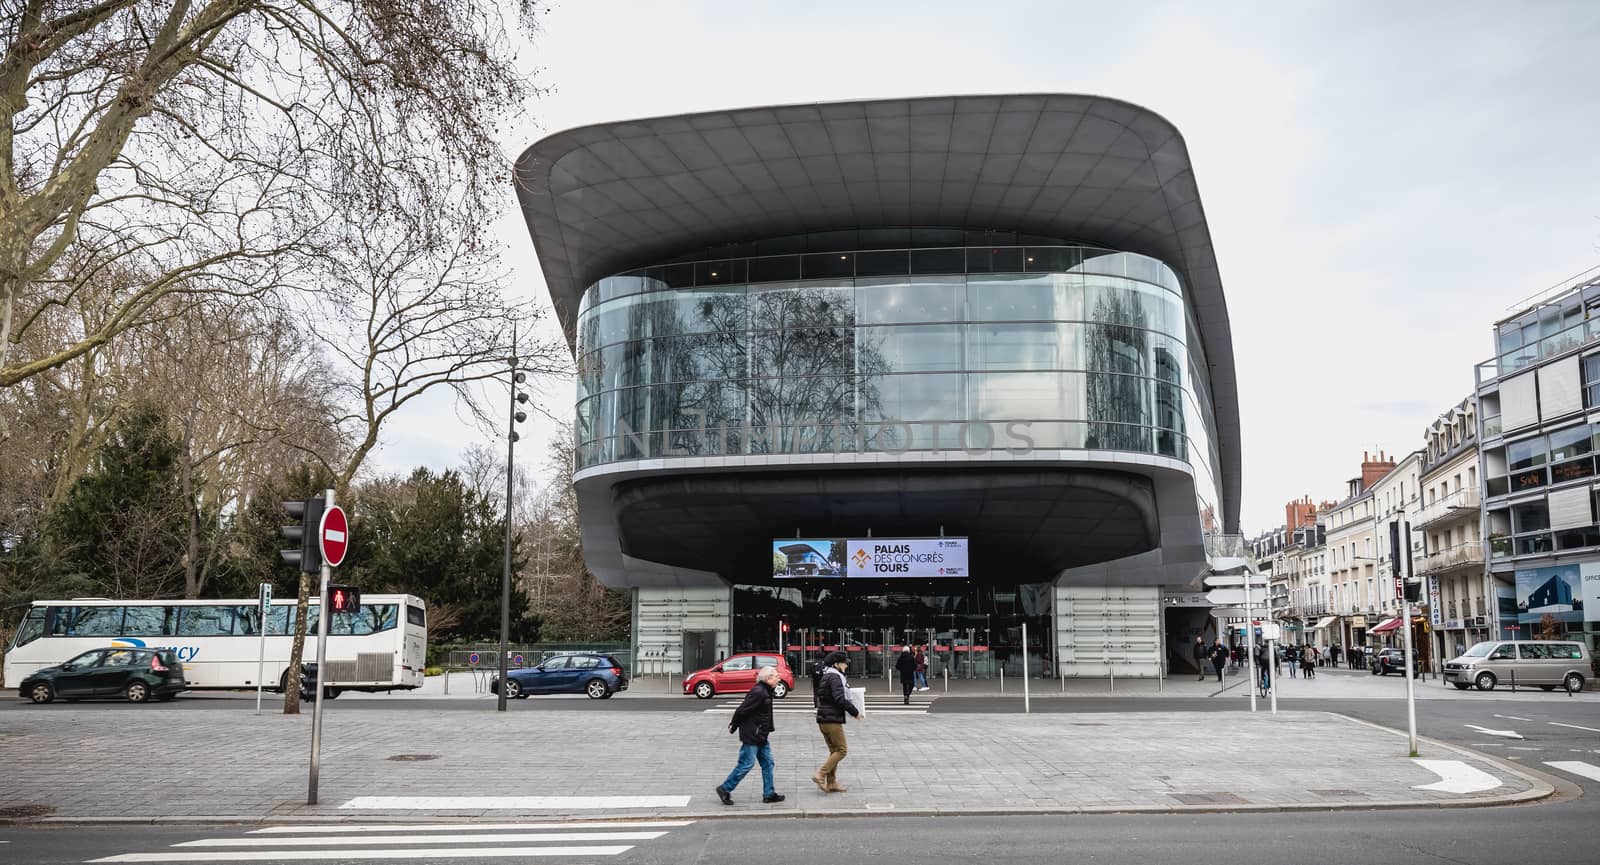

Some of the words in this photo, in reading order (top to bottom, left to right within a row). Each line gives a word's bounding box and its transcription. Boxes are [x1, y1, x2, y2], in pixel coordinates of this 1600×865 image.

[874, 544, 910, 554] PALAIS
[874, 554, 892, 563] DES
[894, 552, 944, 563] CONGRÈS
[874, 563, 909, 573] TOURS
